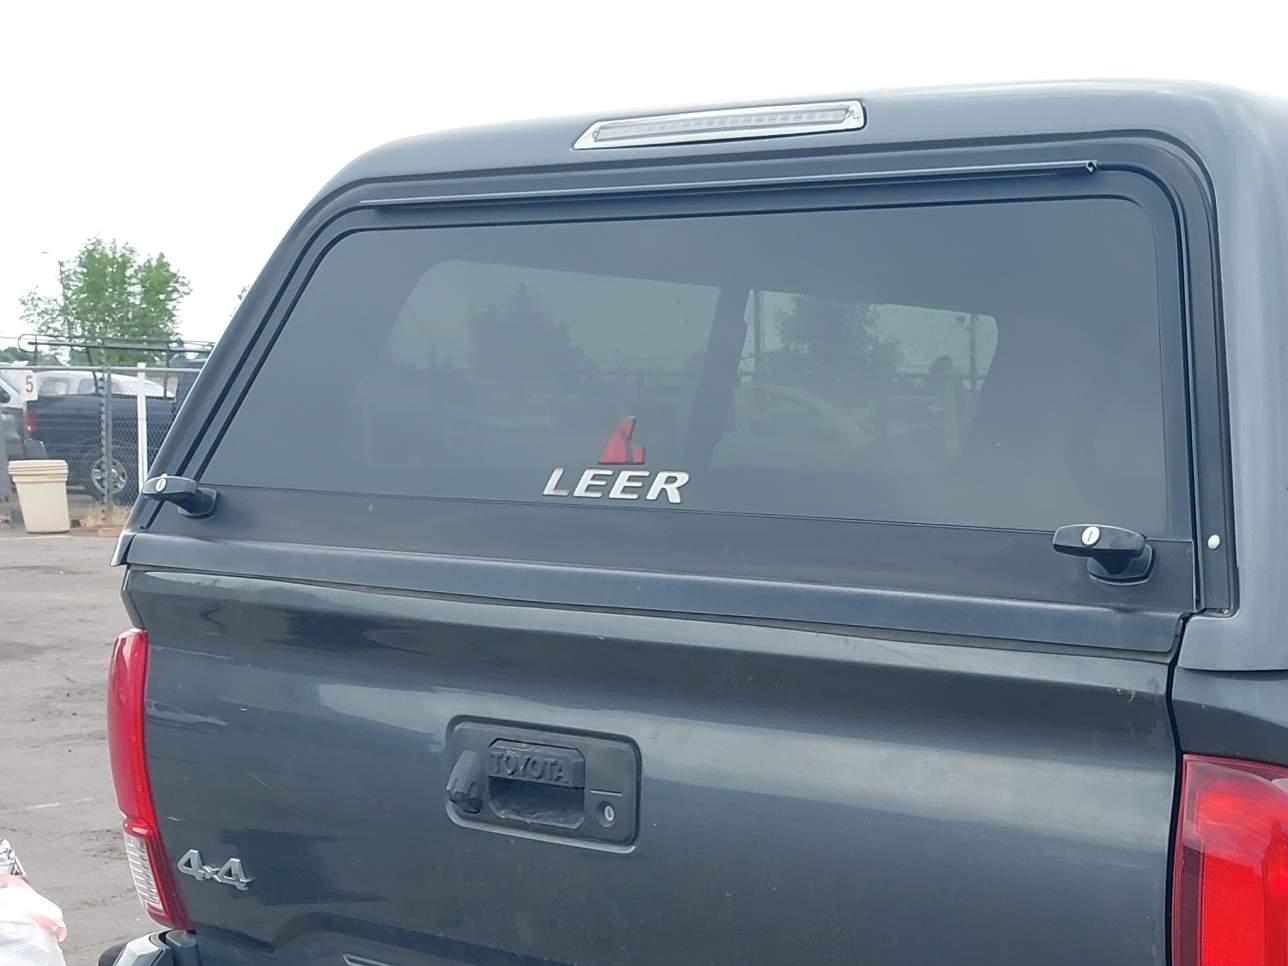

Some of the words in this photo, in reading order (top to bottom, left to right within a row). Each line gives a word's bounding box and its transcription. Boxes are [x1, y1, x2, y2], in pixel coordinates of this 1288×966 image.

[25, 374, 34, 393] 5
[542, 467, 690, 504] LEER
[490, 751, 572, 785] TOYOTA
